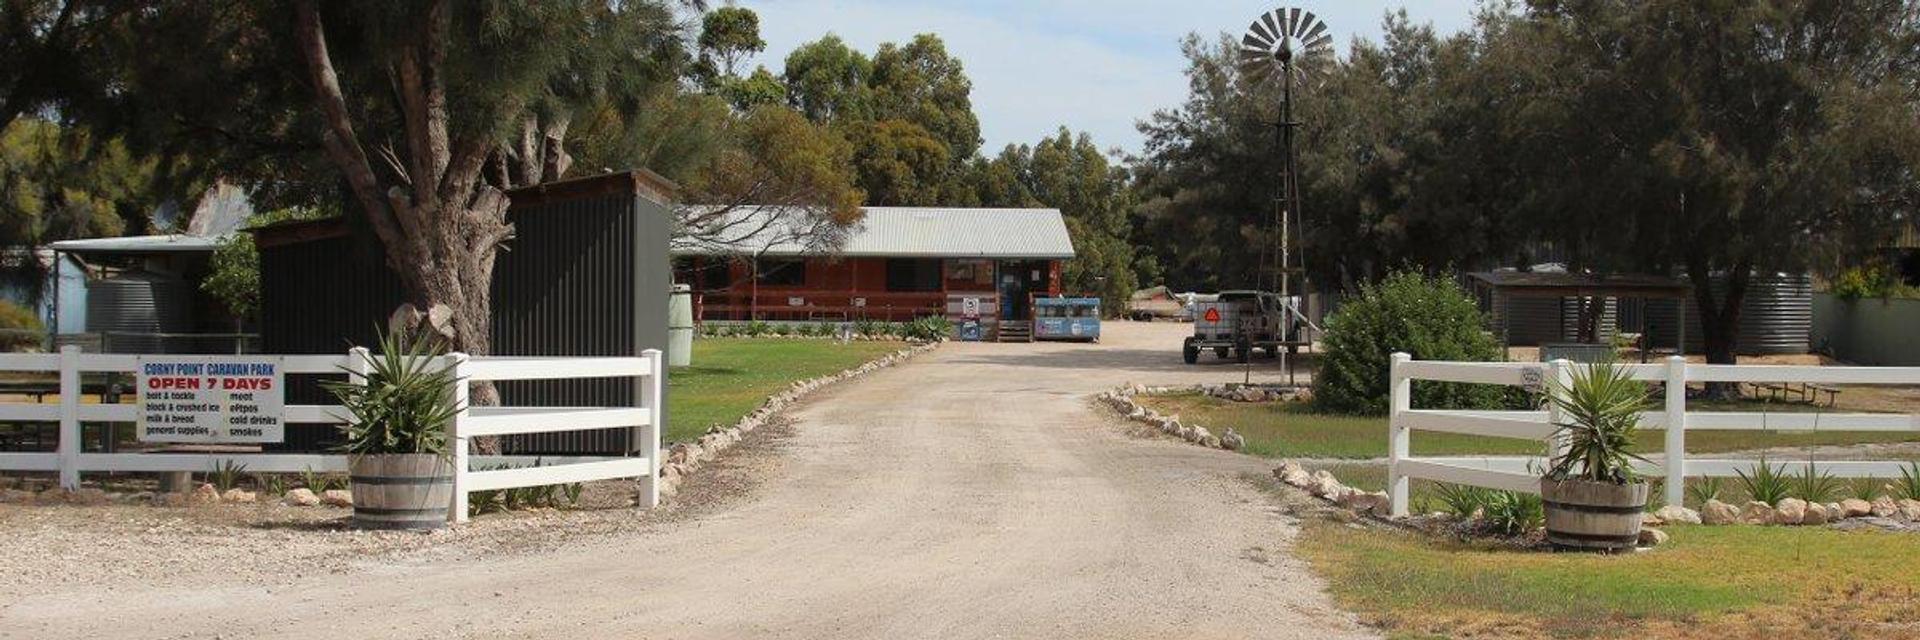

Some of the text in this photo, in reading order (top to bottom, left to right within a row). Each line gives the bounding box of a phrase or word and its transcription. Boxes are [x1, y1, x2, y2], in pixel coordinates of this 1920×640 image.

[145, 364, 274, 374] CORNY POINT CARAVAN PARK
[148, 378, 272, 390] OPEN 7 DAYS
[146, 403, 166, 412] block
[176, 404, 206, 412] crushed
[172, 415, 195, 423] bread
[230, 416, 277, 425] cold drinks
[178, 426, 209, 435] supplies
